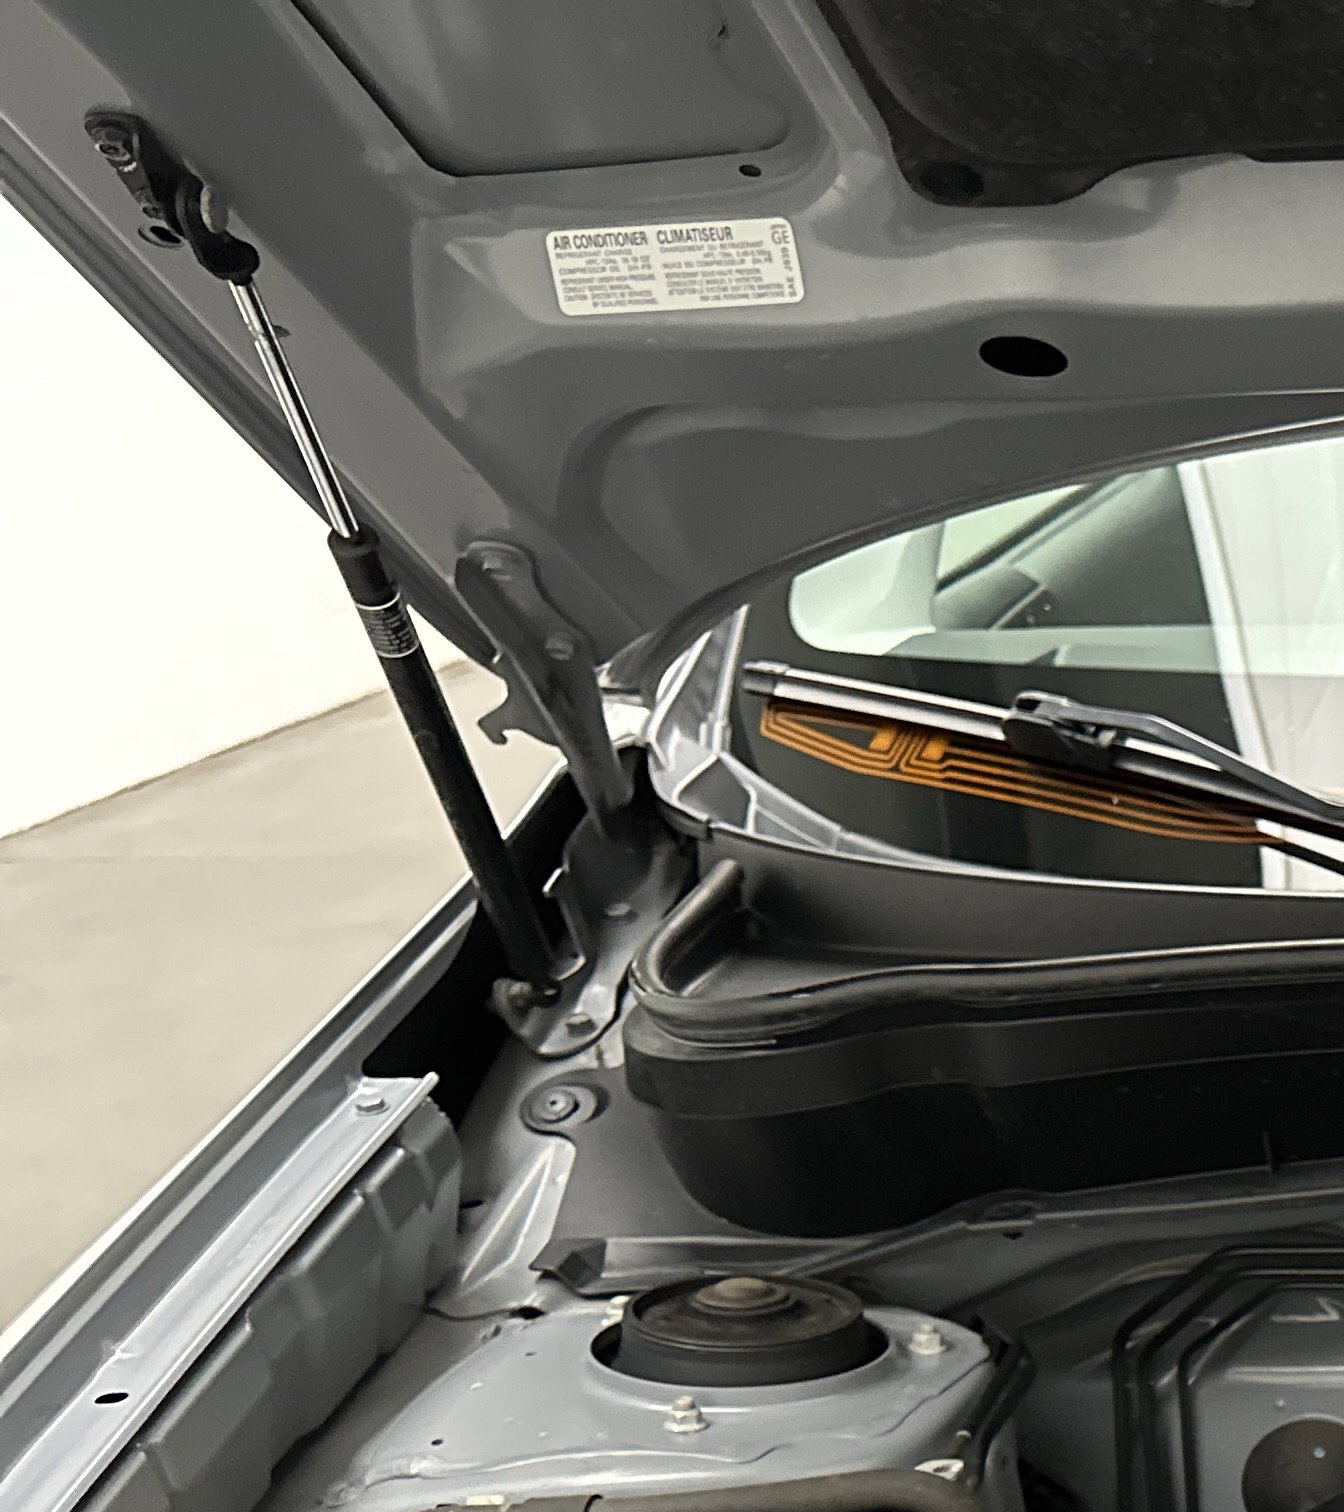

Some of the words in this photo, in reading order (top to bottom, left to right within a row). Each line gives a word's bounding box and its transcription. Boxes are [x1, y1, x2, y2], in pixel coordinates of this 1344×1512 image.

[553, 236, 573, 251] AIR
[573, 231, 649, 250] CONDITIONER
[656, 226, 734, 245] CLIMATISEUR
